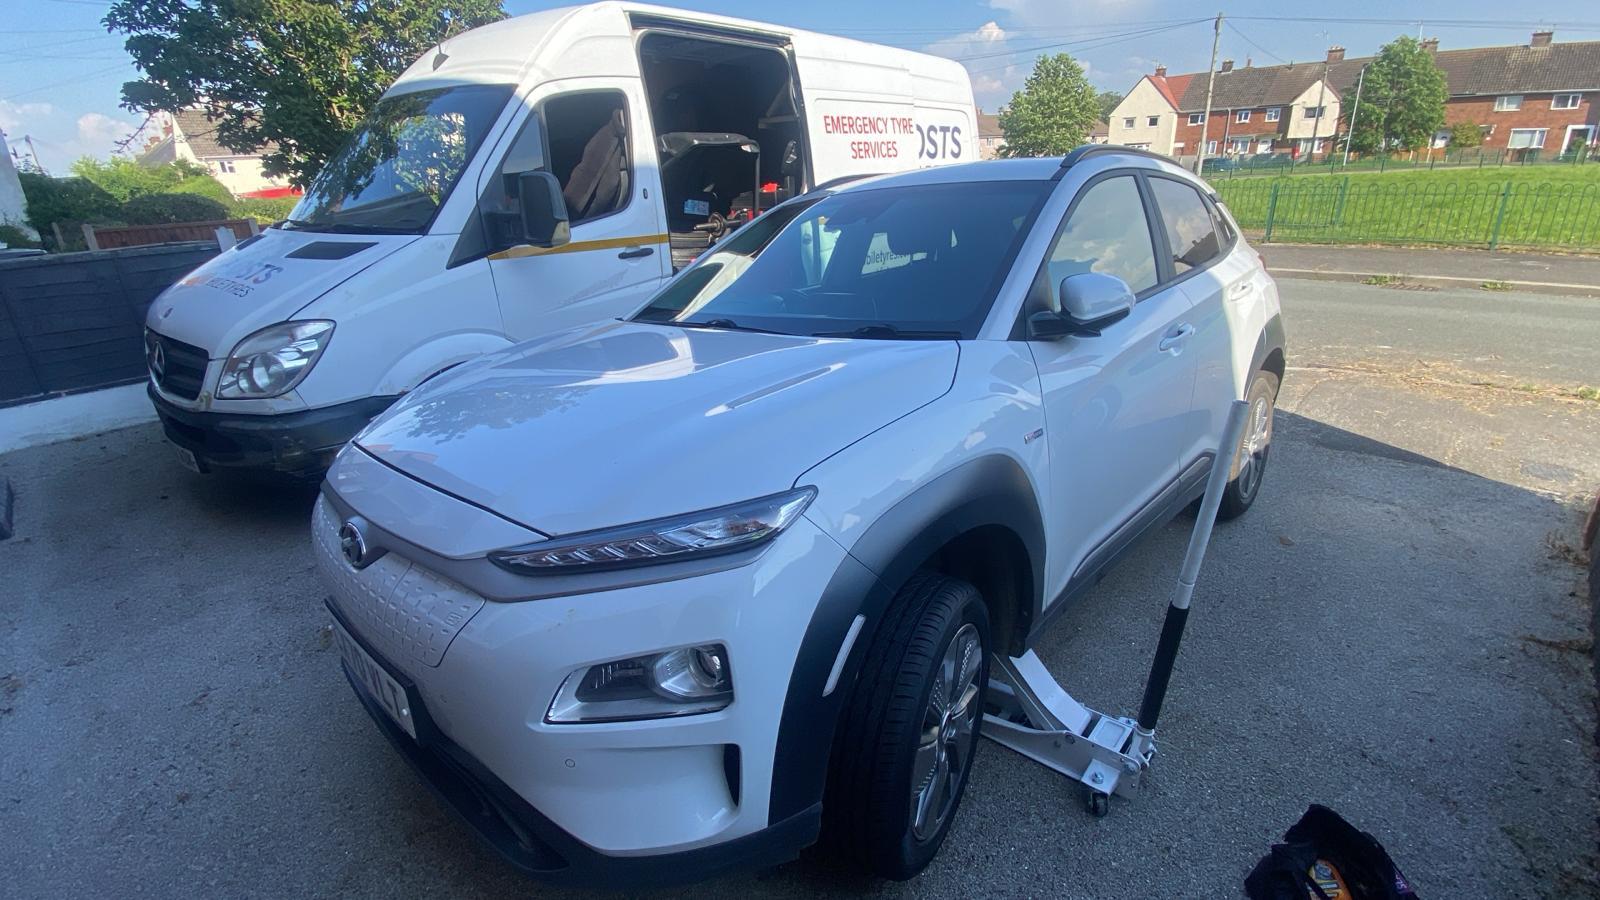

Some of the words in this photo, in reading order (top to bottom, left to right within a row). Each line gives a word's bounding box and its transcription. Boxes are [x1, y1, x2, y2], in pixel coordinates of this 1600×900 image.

[824, 115, 888, 134] EMERGENCY
[890, 117, 914, 134] TYRE
[851, 141, 898, 159] SERVICES
